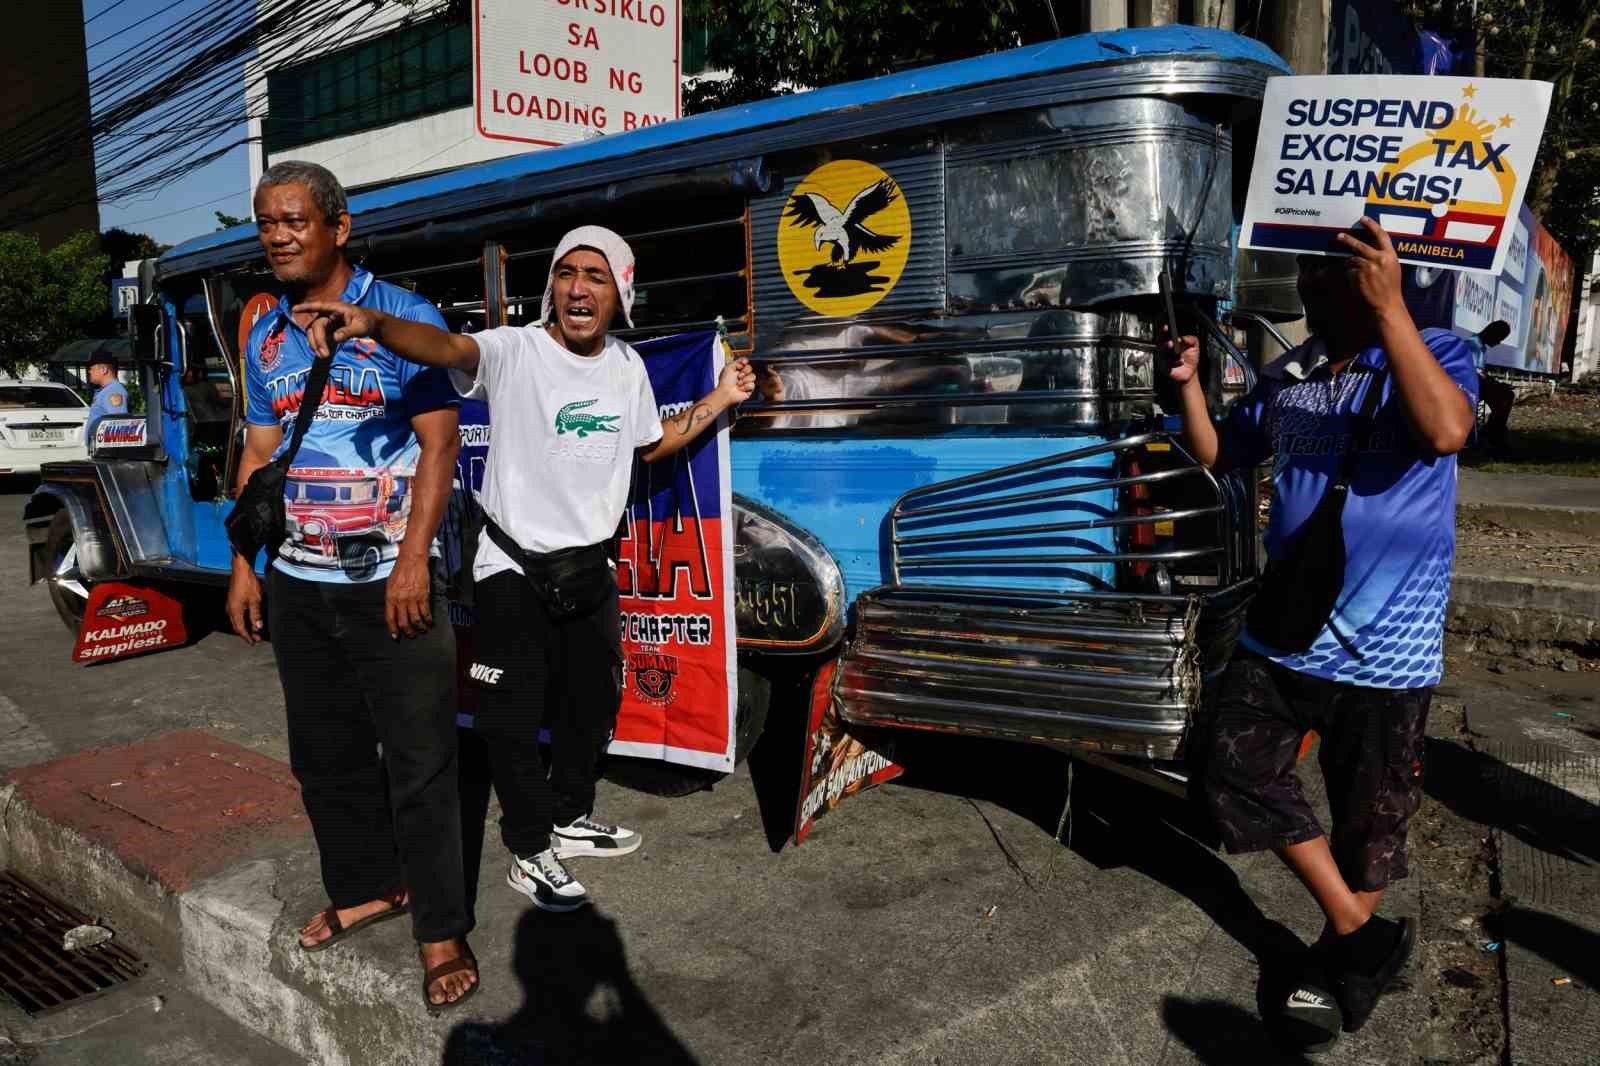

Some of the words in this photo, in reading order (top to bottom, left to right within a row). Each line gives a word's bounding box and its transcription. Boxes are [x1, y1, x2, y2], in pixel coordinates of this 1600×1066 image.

[568, 22, 600, 50] SA
[519, 50, 588, 84] LOOB
[609, 67, 643, 94] NG
[492, 89, 607, 129] LOADING
[1286, 98, 1455, 130] SUSPEND
[1280, 134, 1404, 164] EXCISE
[1432, 138, 1511, 173] TAX
[1274, 168, 1316, 196] SA
[1322, 169, 1463, 206] LANGIS!
[1273, 206, 1321, 217] #OilPriceHike
[1397, 241, 1465, 260] MANIBELA
[345, 409, 384, 421] CHAPTER
[84, 619, 167, 643] KALMADO
[630, 612, 712, 645] CHAPTER
[640, 645, 661, 653] TEAM
[469, 663, 503, 685] NIKE
[1295, 989, 1324, 1005] NIKE
